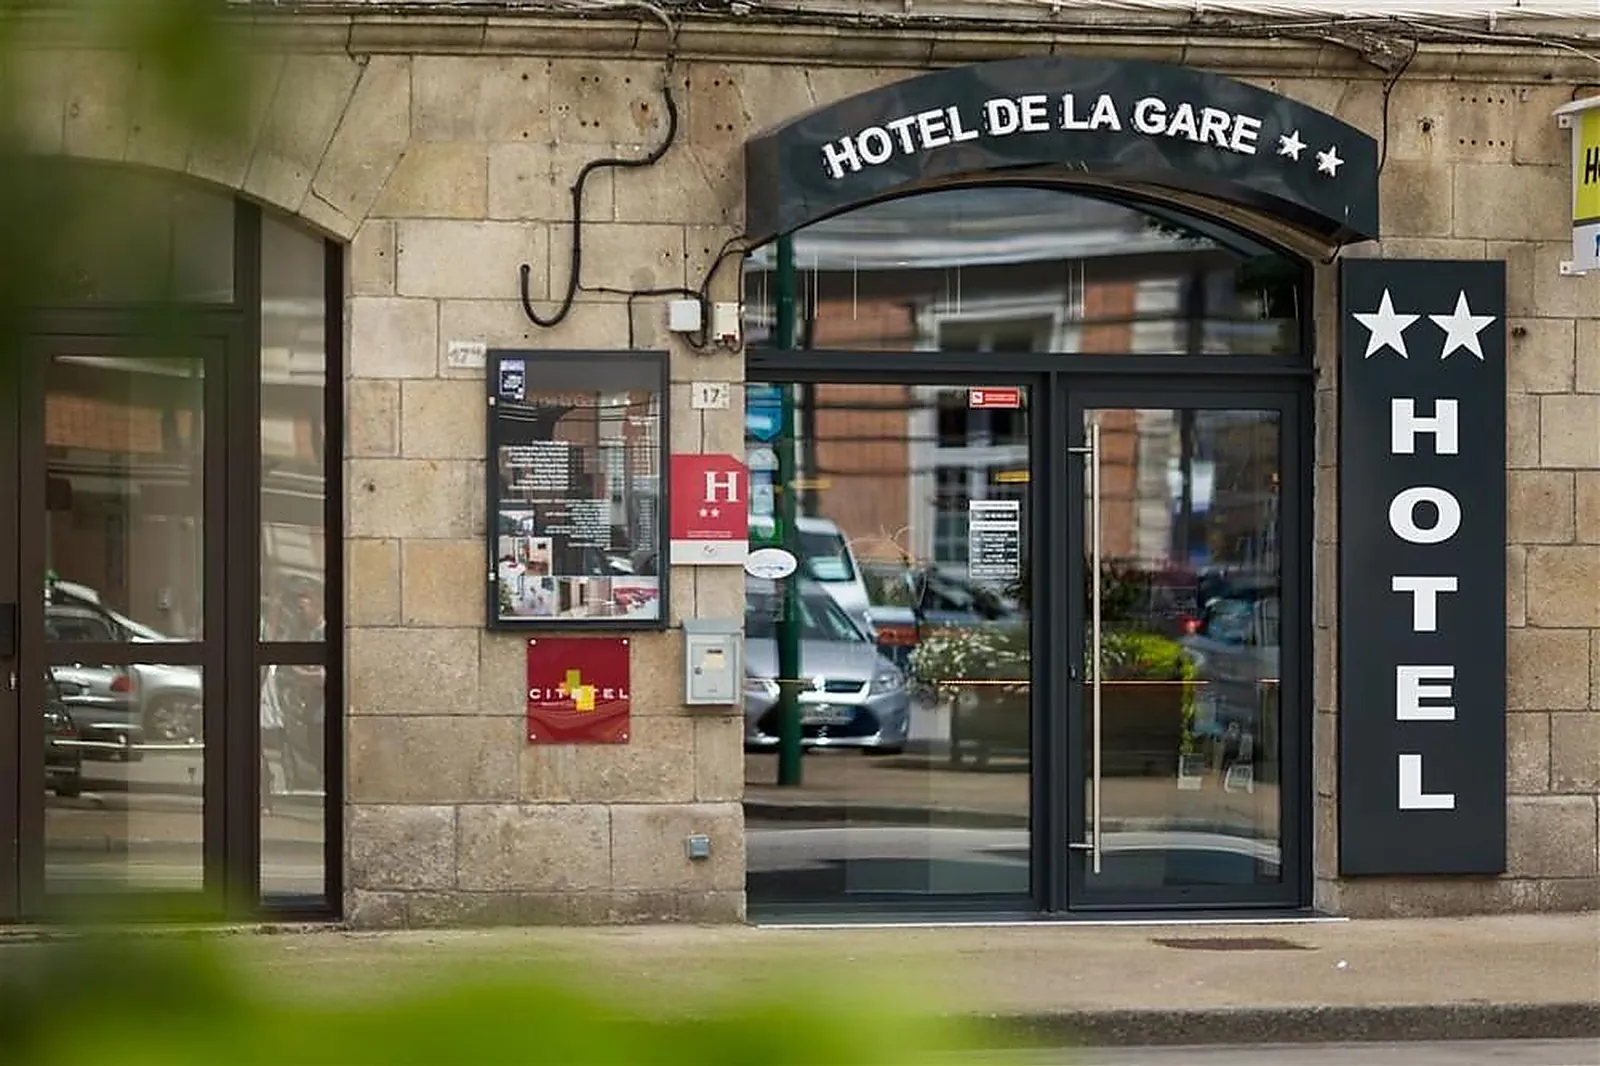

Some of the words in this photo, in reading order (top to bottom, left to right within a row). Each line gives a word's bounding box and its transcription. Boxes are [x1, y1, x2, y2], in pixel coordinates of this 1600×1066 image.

[822, 106, 979, 179] HOTEL
[986, 94, 1050, 136] DE
[1061, 93, 1122, 132] LA
[1132, 97, 1262, 155] GARE
[1584, 146, 1600, 185] H
[703, 388, 720, 403] 17
[704, 471, 740, 502] H
[1388, 398, 1461, 809] HOTEL
